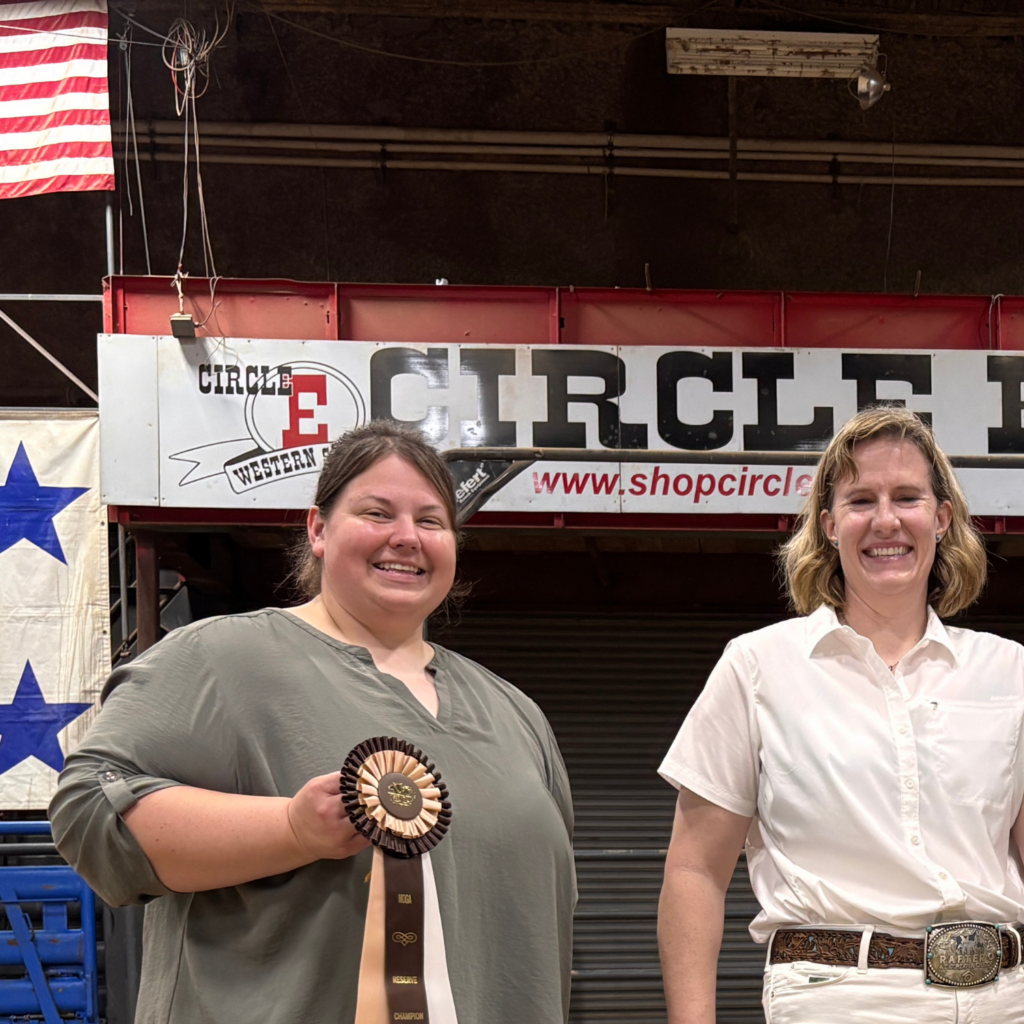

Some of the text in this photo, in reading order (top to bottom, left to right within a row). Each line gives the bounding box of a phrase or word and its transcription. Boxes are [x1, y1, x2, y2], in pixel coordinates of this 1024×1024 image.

[199, 364, 328, 449] CIRCLE E
[370, 346, 932, 451] CIRCLE
[232, 447, 317, 487] WESTERN
[532, 465, 813, 504] www.shopcircle
[392, 975, 419, 984] RESERVE
[394, 1012, 424, 1021] CHAMPION
